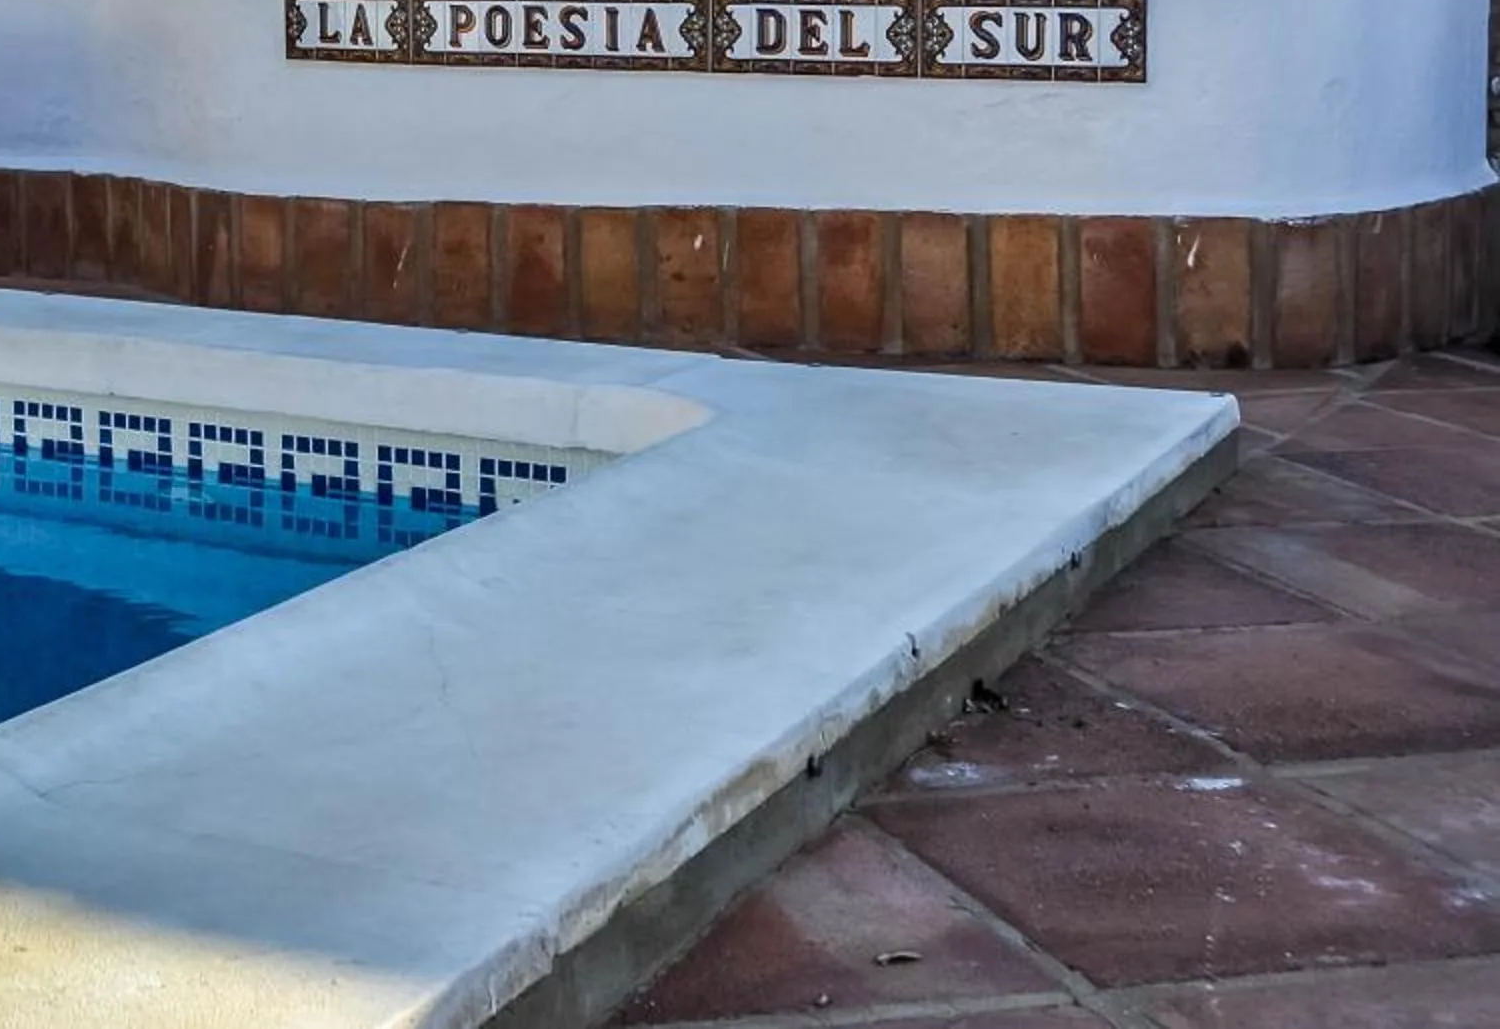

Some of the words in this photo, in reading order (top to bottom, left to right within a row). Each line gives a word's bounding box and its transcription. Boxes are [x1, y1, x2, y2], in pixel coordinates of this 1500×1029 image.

[317, 2, 374, 46] LA
[449, 4, 667, 53] POESIA
[755, 8, 871, 57] DEL
[969, 10, 1093, 62] SUR
